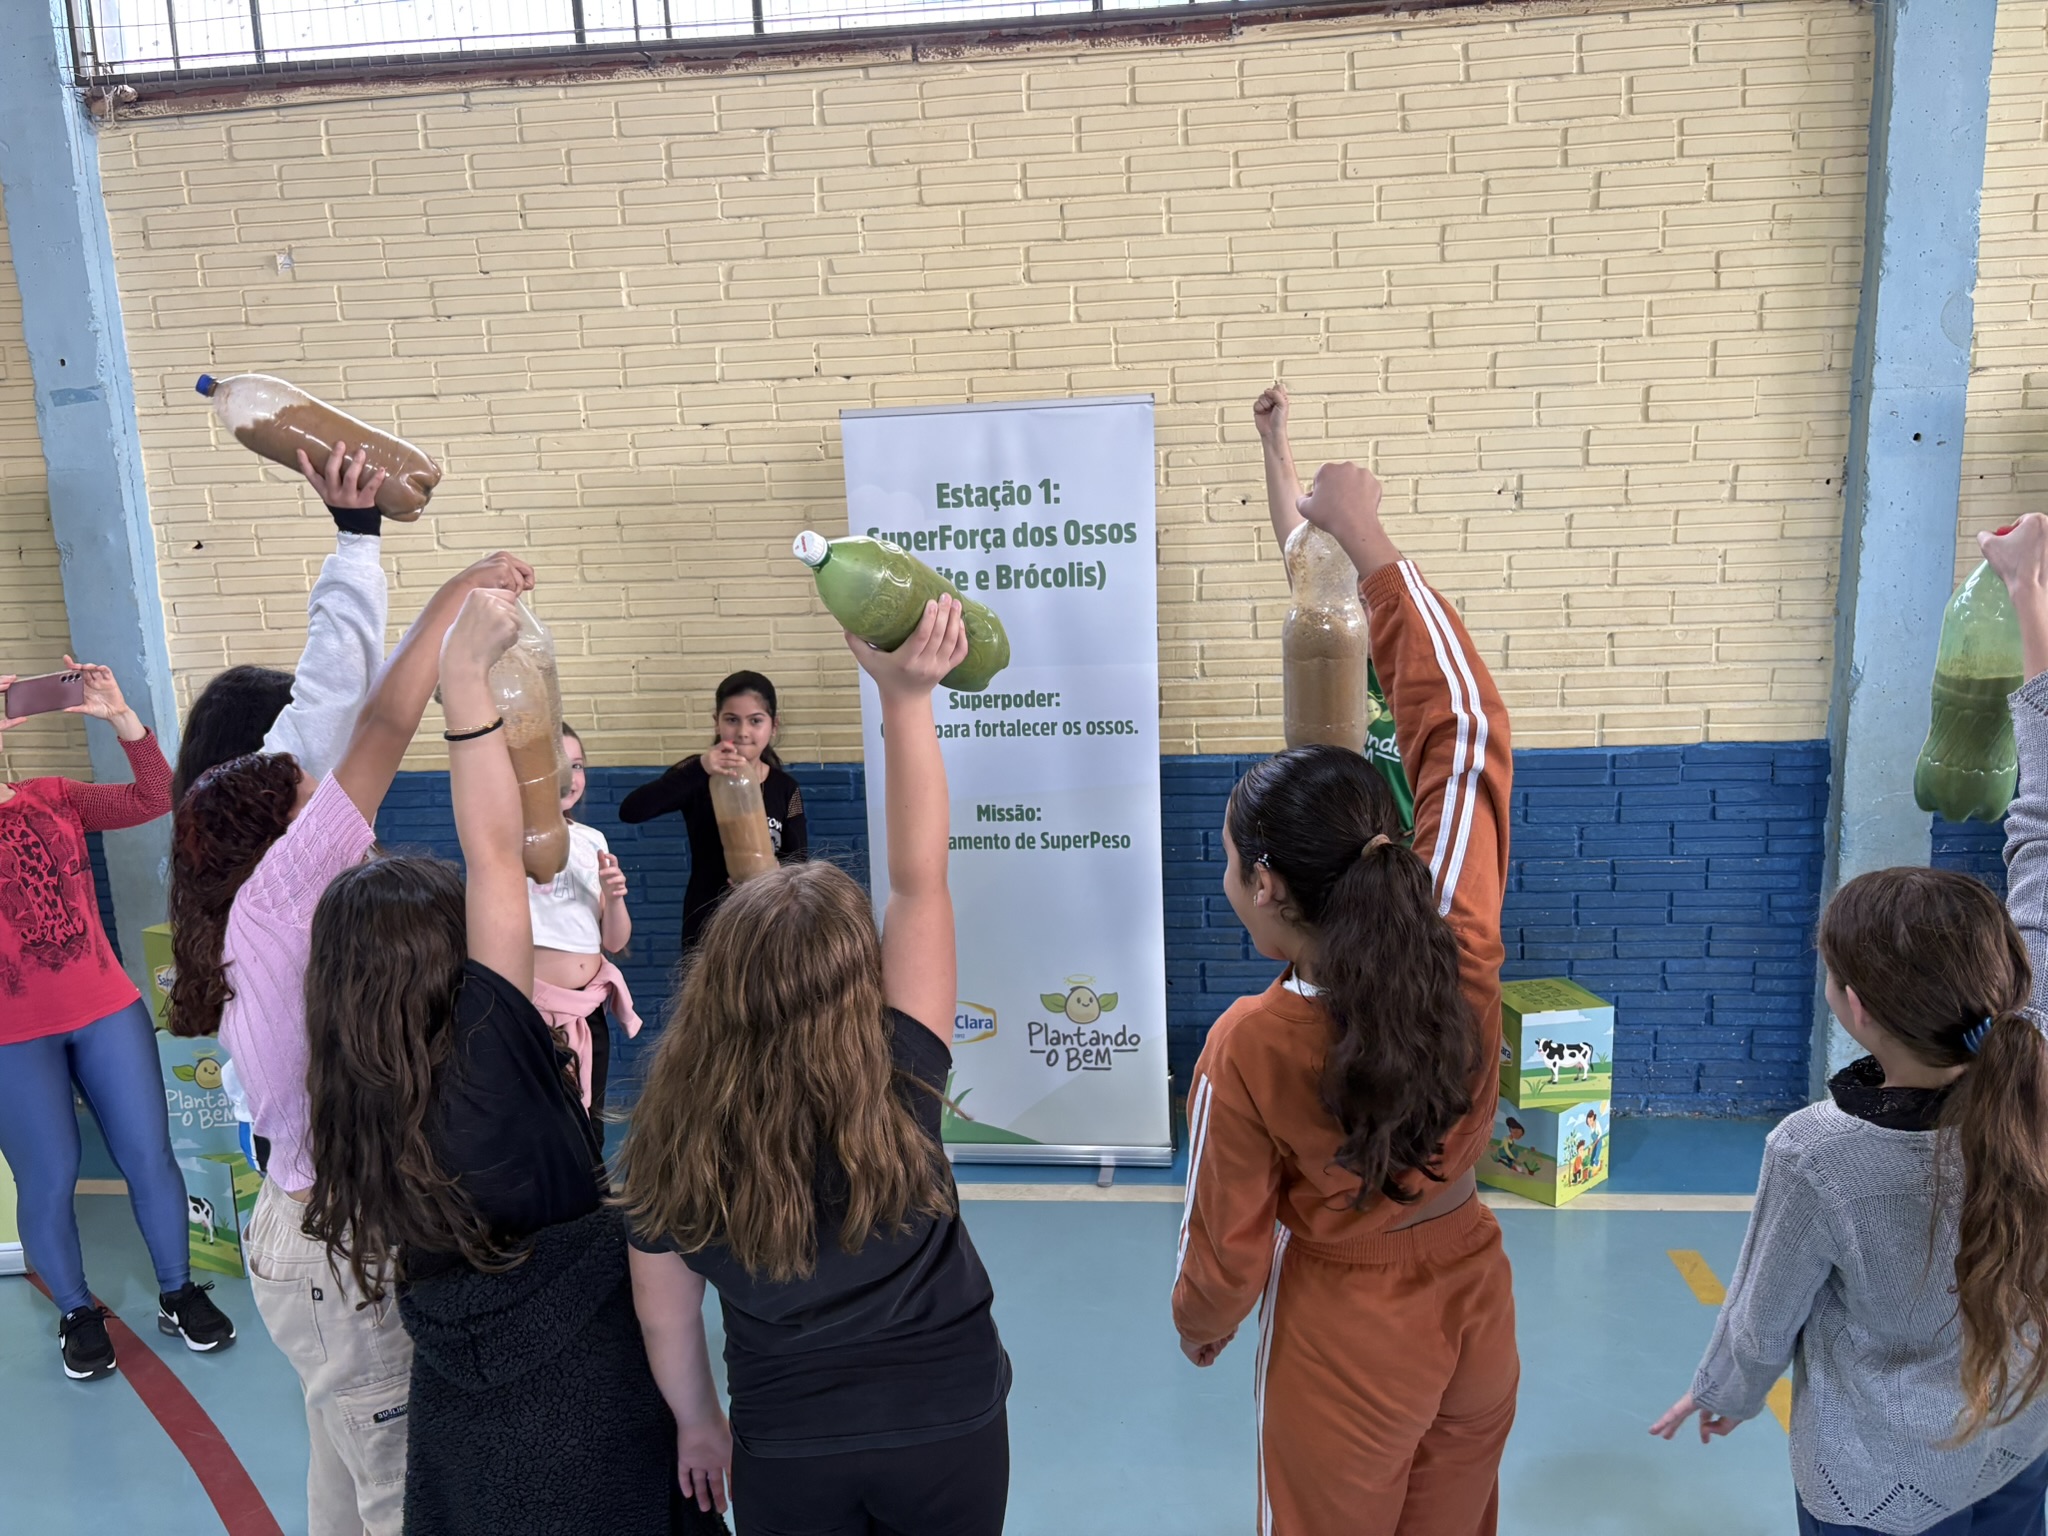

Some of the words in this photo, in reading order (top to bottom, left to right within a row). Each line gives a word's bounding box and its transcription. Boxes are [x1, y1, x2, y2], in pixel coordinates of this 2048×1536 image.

[936, 480, 1031, 511] Estação
[1038, 479, 1060, 504] 1:
[1013, 522, 1057, 548] dos
[1064, 520, 1137, 545] Ossos
[976, 570, 989, 590] e
[996, 561, 1106, 590] Brócolis)
[949, 690, 1060, 711] Superpoder:
[935, 724, 970, 738] para
[975, 719, 1057, 737] fortalecer
[1063, 721, 1081, 735] os
[1086, 720, 1138, 735] ossos.
[977, 805, 1041, 822] Missão:
[949, 834, 1010, 850] amento
[1015, 832, 1035, 849] de
[1041, 831, 1130, 851] SuperPeso
[955, 1014, 993, 1029] Clara
[1027, 1022, 1141, 1046] Plantando
[1065, 1047, 1112, 1071] BeM
[1501, 1046, 1511, 1059] ara
[166, 1089, 233, 1110] Planta
